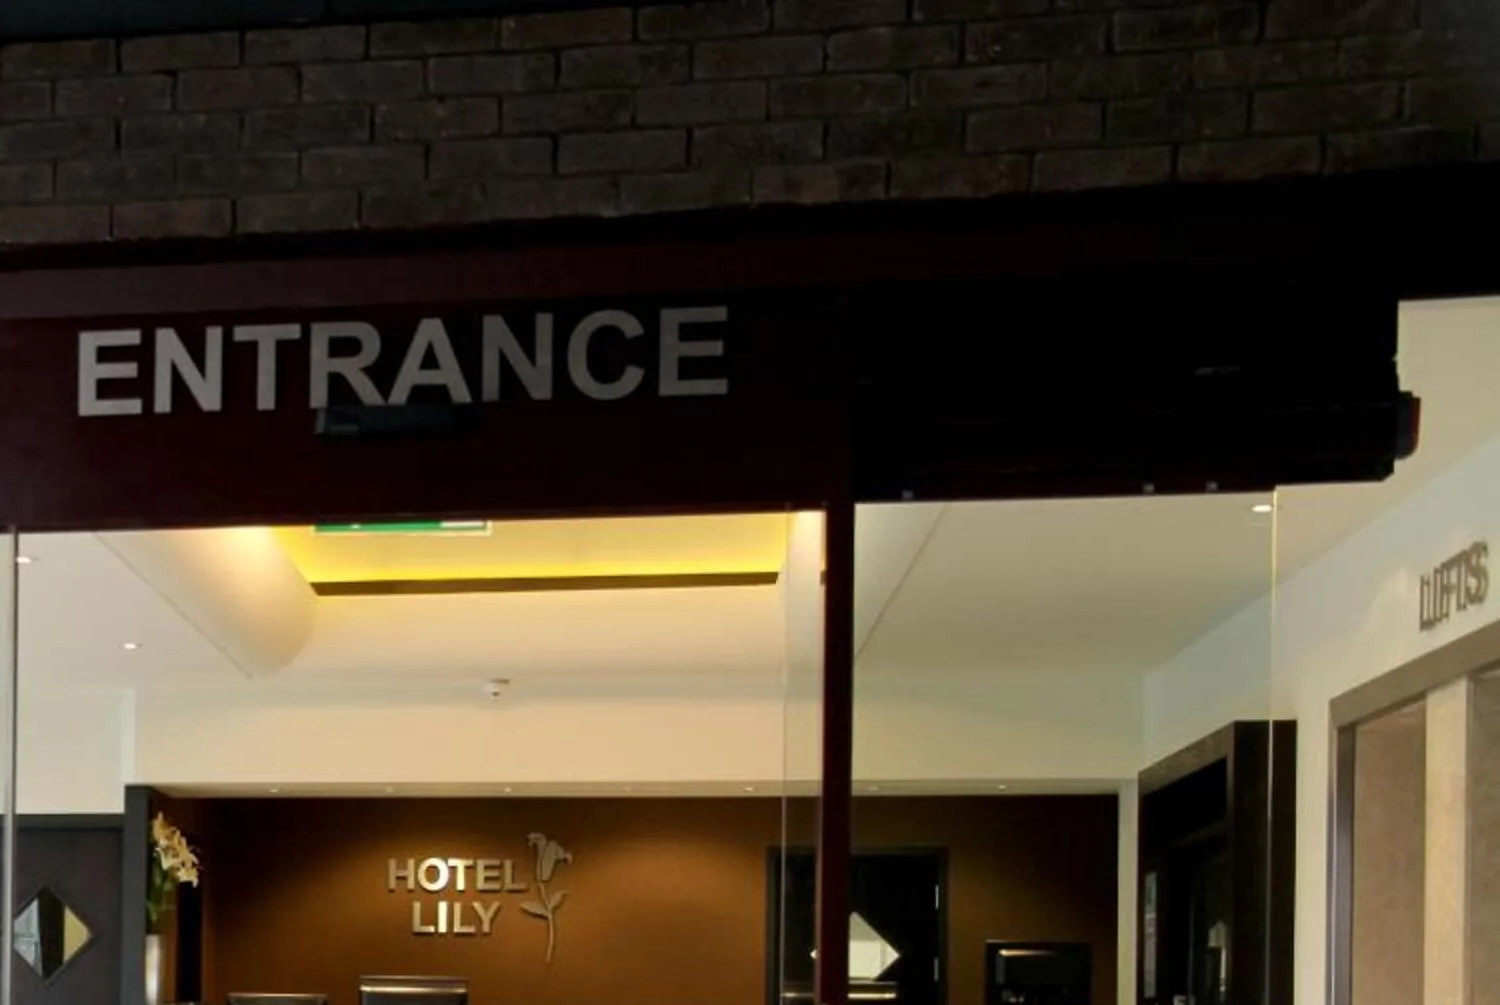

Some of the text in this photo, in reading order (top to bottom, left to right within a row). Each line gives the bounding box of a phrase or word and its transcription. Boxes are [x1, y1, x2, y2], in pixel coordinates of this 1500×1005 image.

[77, 306, 729, 417] ENTRANCE
[388, 857, 528, 892] HOTEL
[412, 901, 500, 934] LILY
